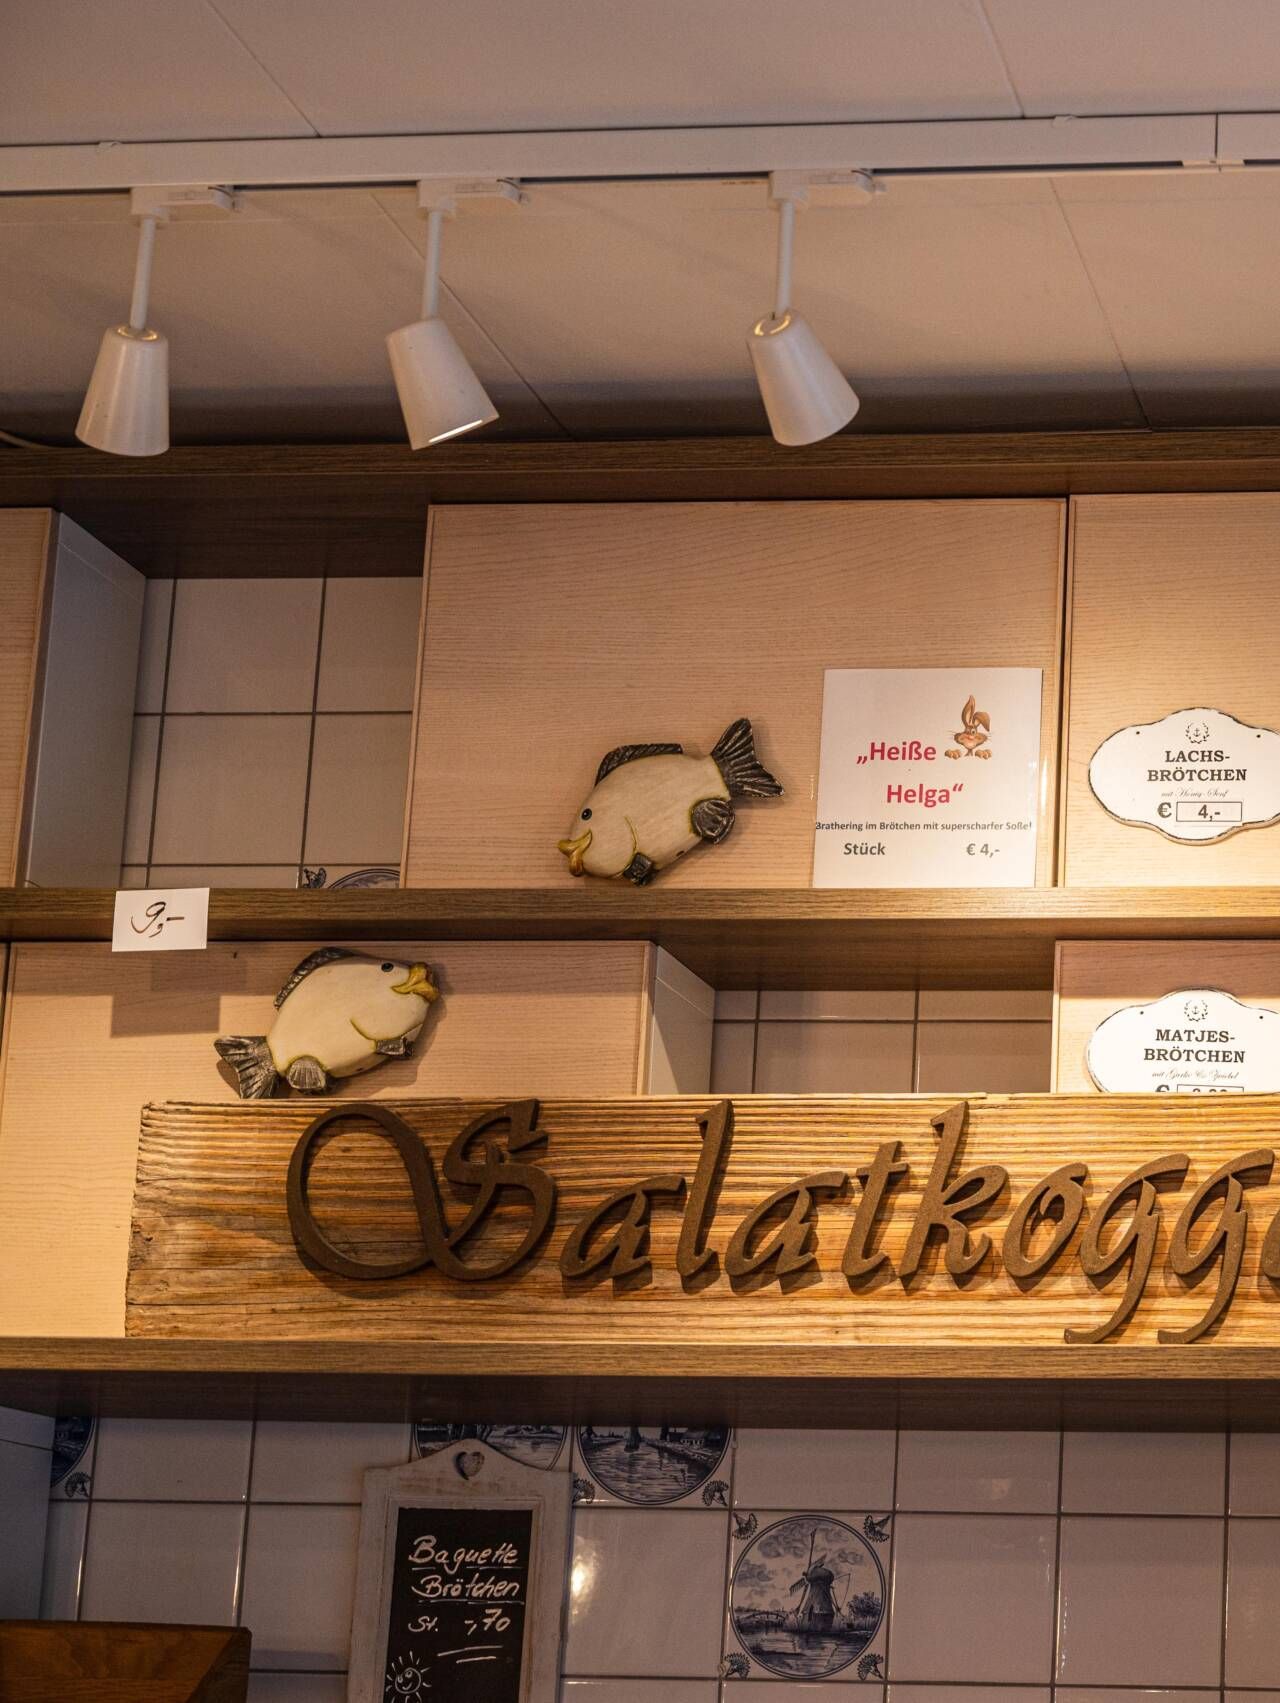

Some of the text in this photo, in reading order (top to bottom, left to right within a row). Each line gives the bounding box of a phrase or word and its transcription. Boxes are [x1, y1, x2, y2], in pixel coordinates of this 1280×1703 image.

[856, 741, 937, 764] „Heiße
[1164, 750, 1231, 763] LACHS-
[1147, 766, 1247, 782] BRÖTCHEN
[1157, 802, 1221, 822] € 4,-
[815, 821, 1032, 832] Brathering im Brötchen mit superscharfer Soße!
[843, 842, 1000, 858] Stück € 4,-
[1155, 1028, 1236, 1043] MATJES-
[1143, 1046, 1246, 1063] BRÖTCHEN
[408, 1534, 519, 1575] Baguette
[411, 1573, 520, 1598] Brötchen
[407, 1615, 439, 1633] St.
